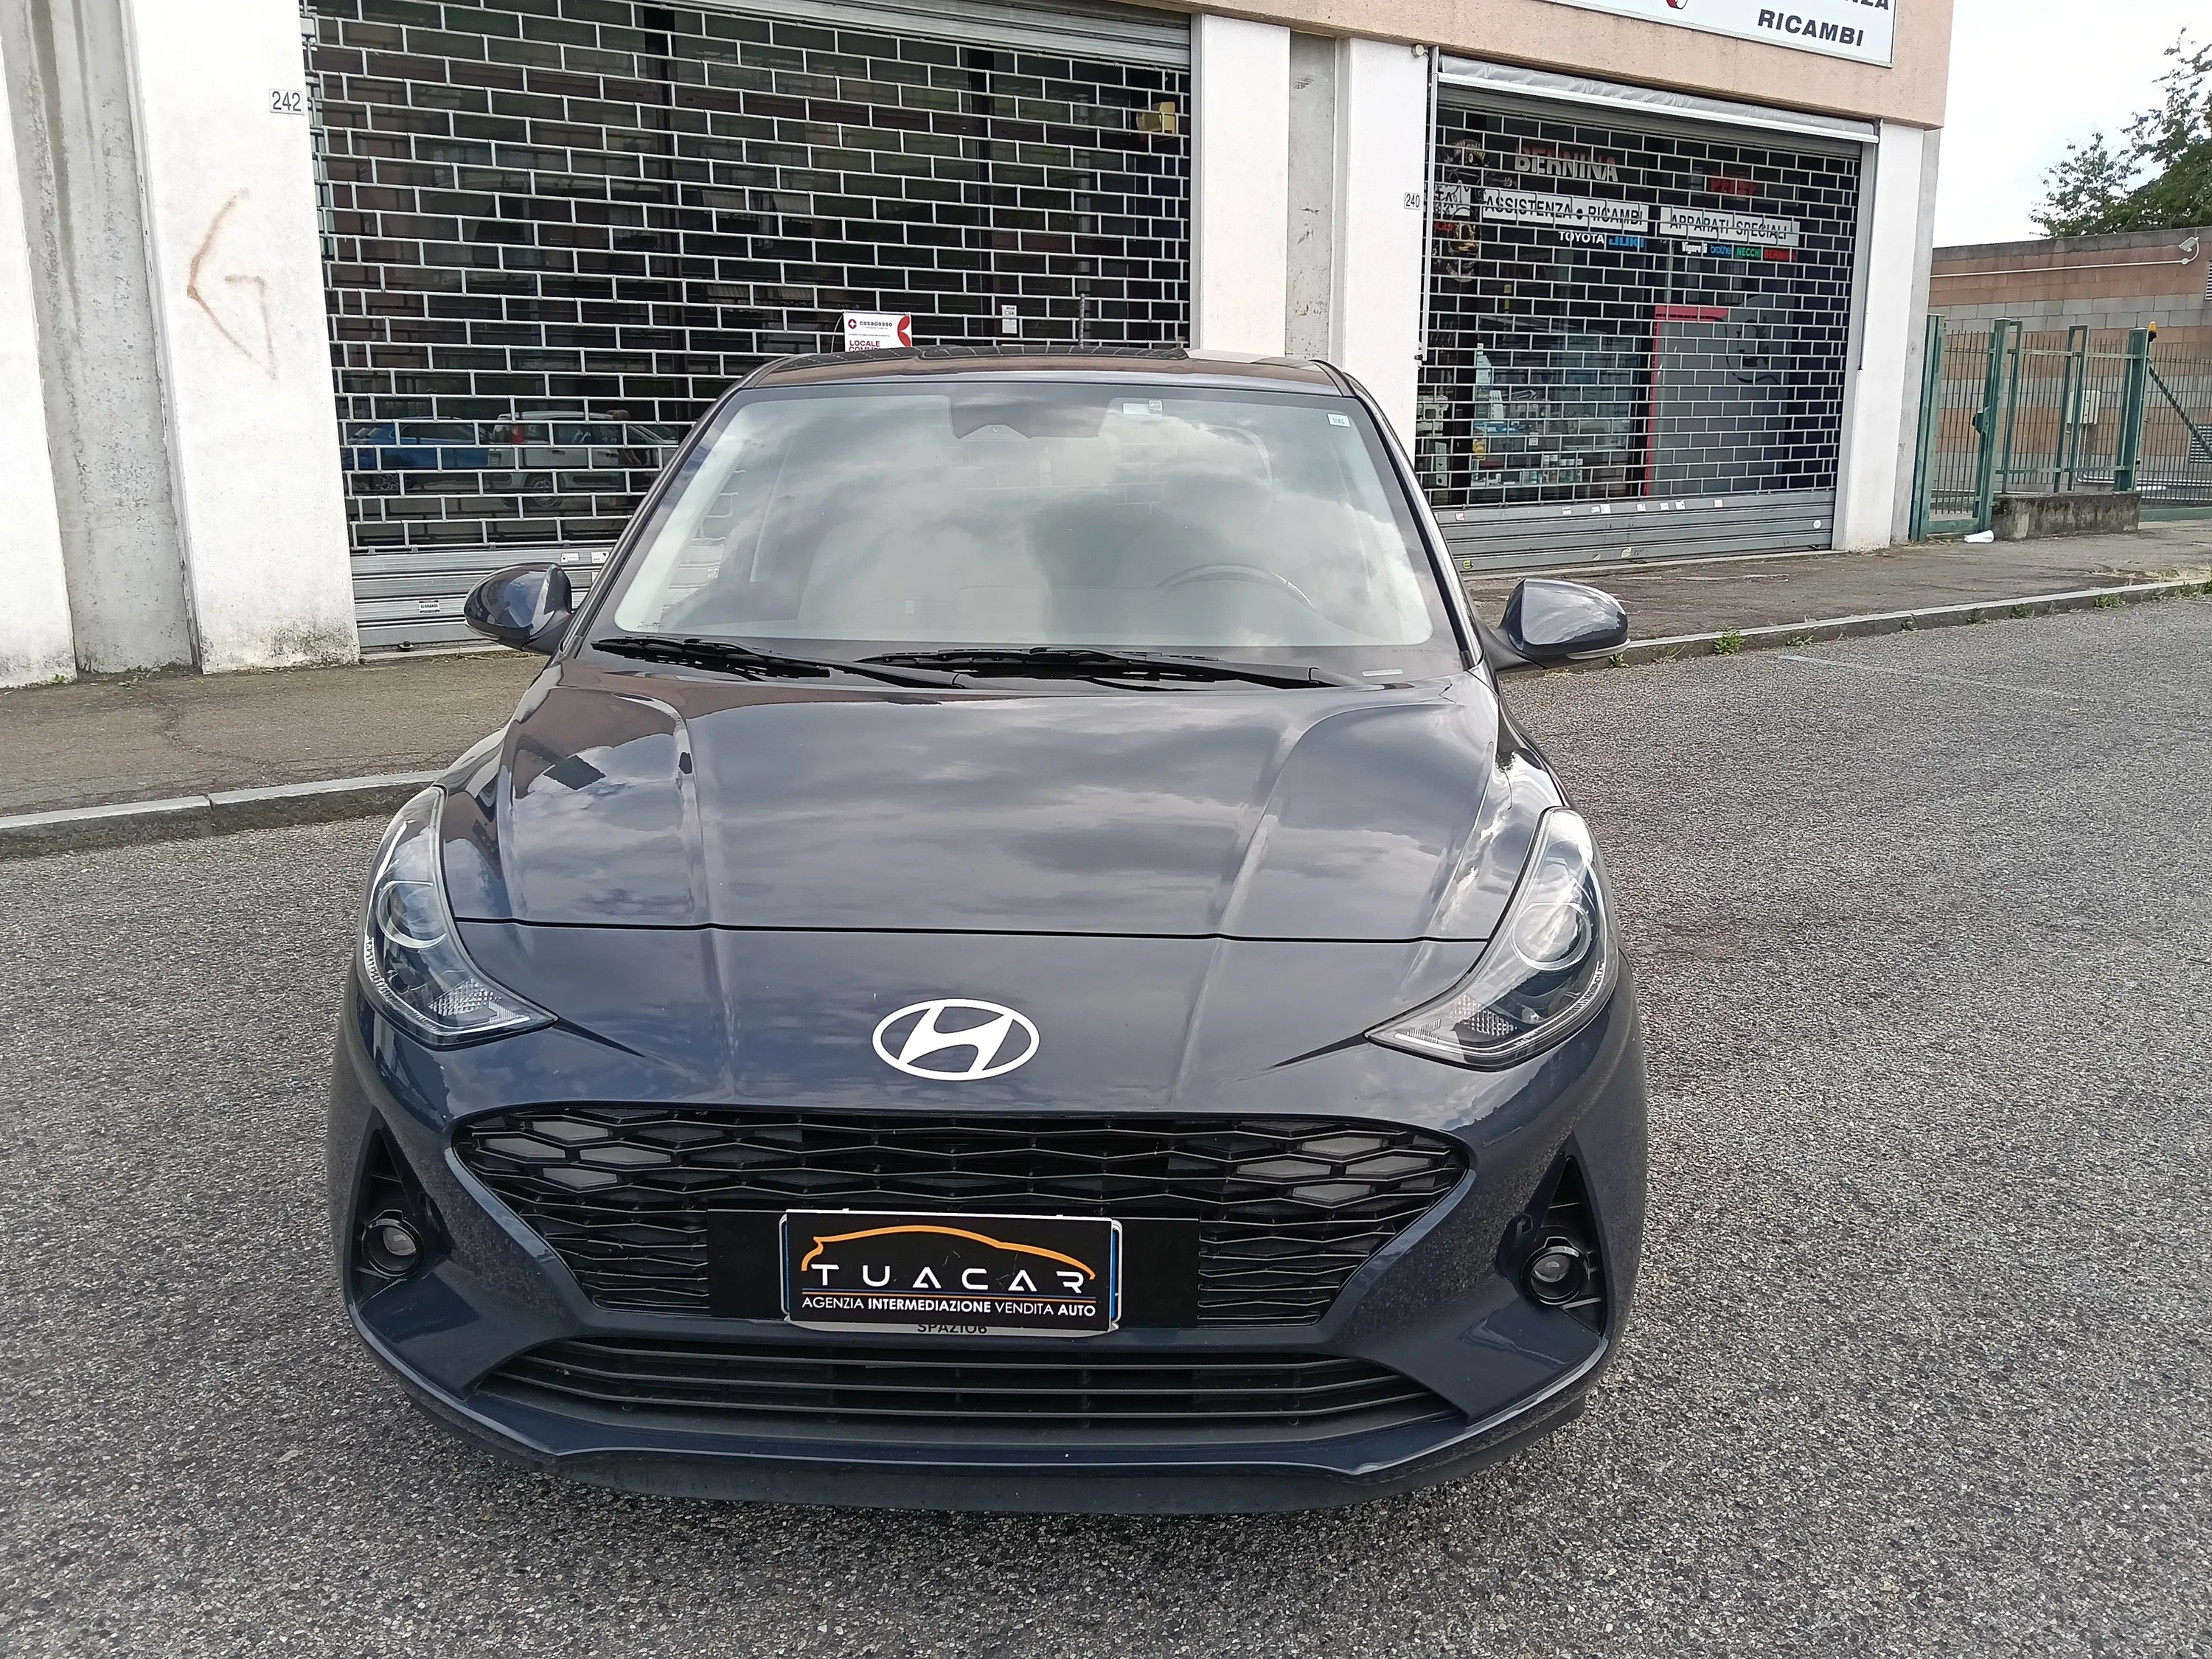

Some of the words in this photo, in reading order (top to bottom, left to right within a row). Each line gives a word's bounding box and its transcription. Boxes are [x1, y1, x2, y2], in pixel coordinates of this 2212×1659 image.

[1757, 9, 1863, 46] RICAMBI
[271, 91, 302, 111] 242
[1514, 145, 1618, 182] BERNINA
[1405, 193, 1420, 208] 240
[1484, 195, 1572, 220] ASSISTENZA
[1587, 205, 1644, 226] RICAMBI
[1558, 231, 1604, 244] TOYOTA
[1669, 213, 1729, 234] APPARATI
[1736, 220, 1787, 240] SPECIALI
[1710, 244, 1733, 255] brothe
[811, 1263, 1085, 1294] TUACAR
[801, 1296, 864, 1310] AGENZIA
[868, 1298, 991, 1313] INTERMEDIAZIONE
[995, 1301, 1054, 1315] VENDITA
[1057, 1304, 1096, 1317] AUTO
